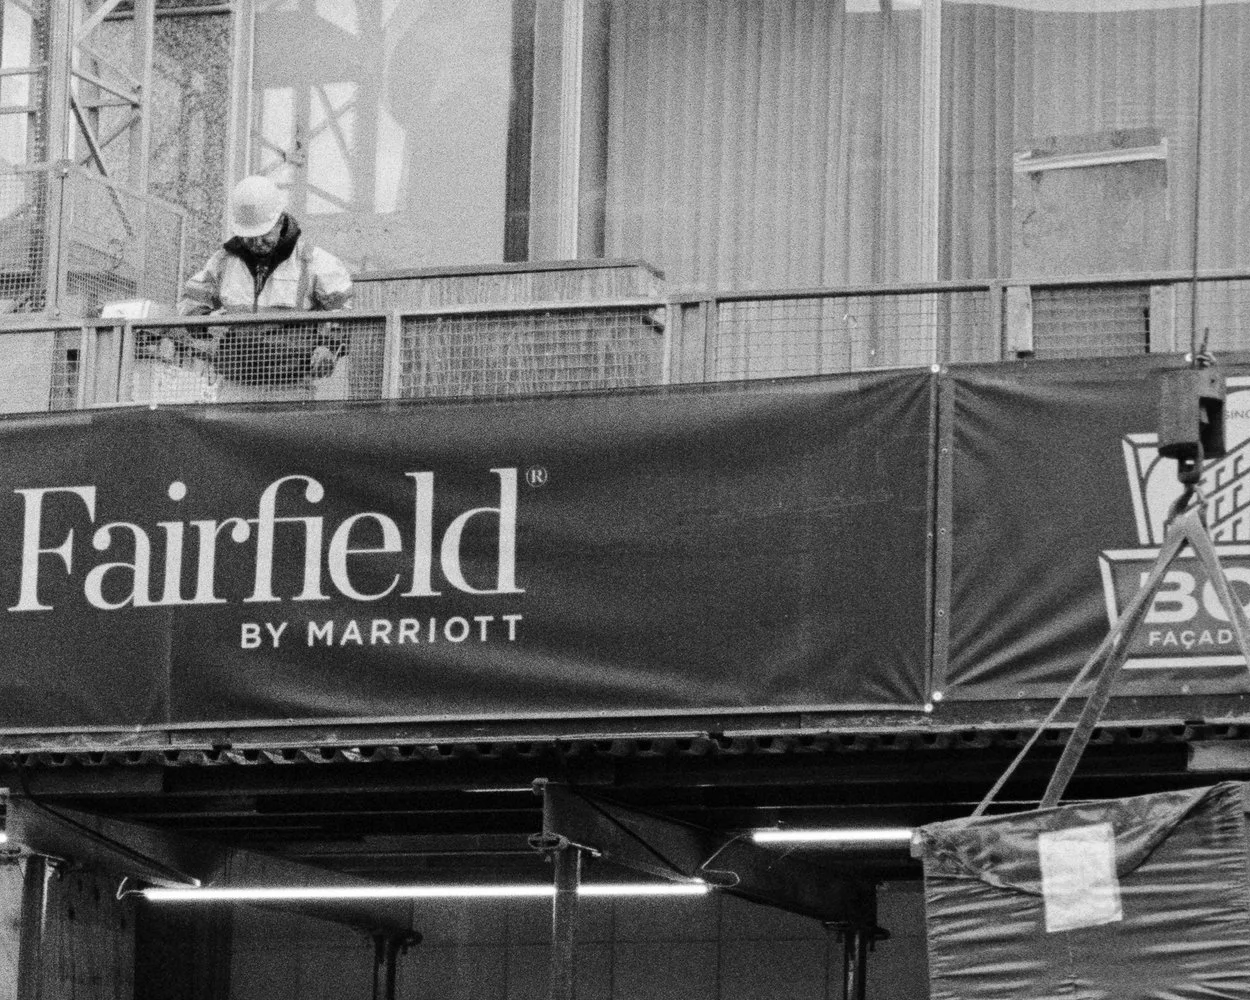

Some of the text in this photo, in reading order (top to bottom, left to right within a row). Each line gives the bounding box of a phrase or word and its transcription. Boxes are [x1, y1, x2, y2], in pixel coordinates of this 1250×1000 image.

[241, 615, 523, 649] BY MARRIOTT
[1150, 629, 1234, 648] FAÇAD
